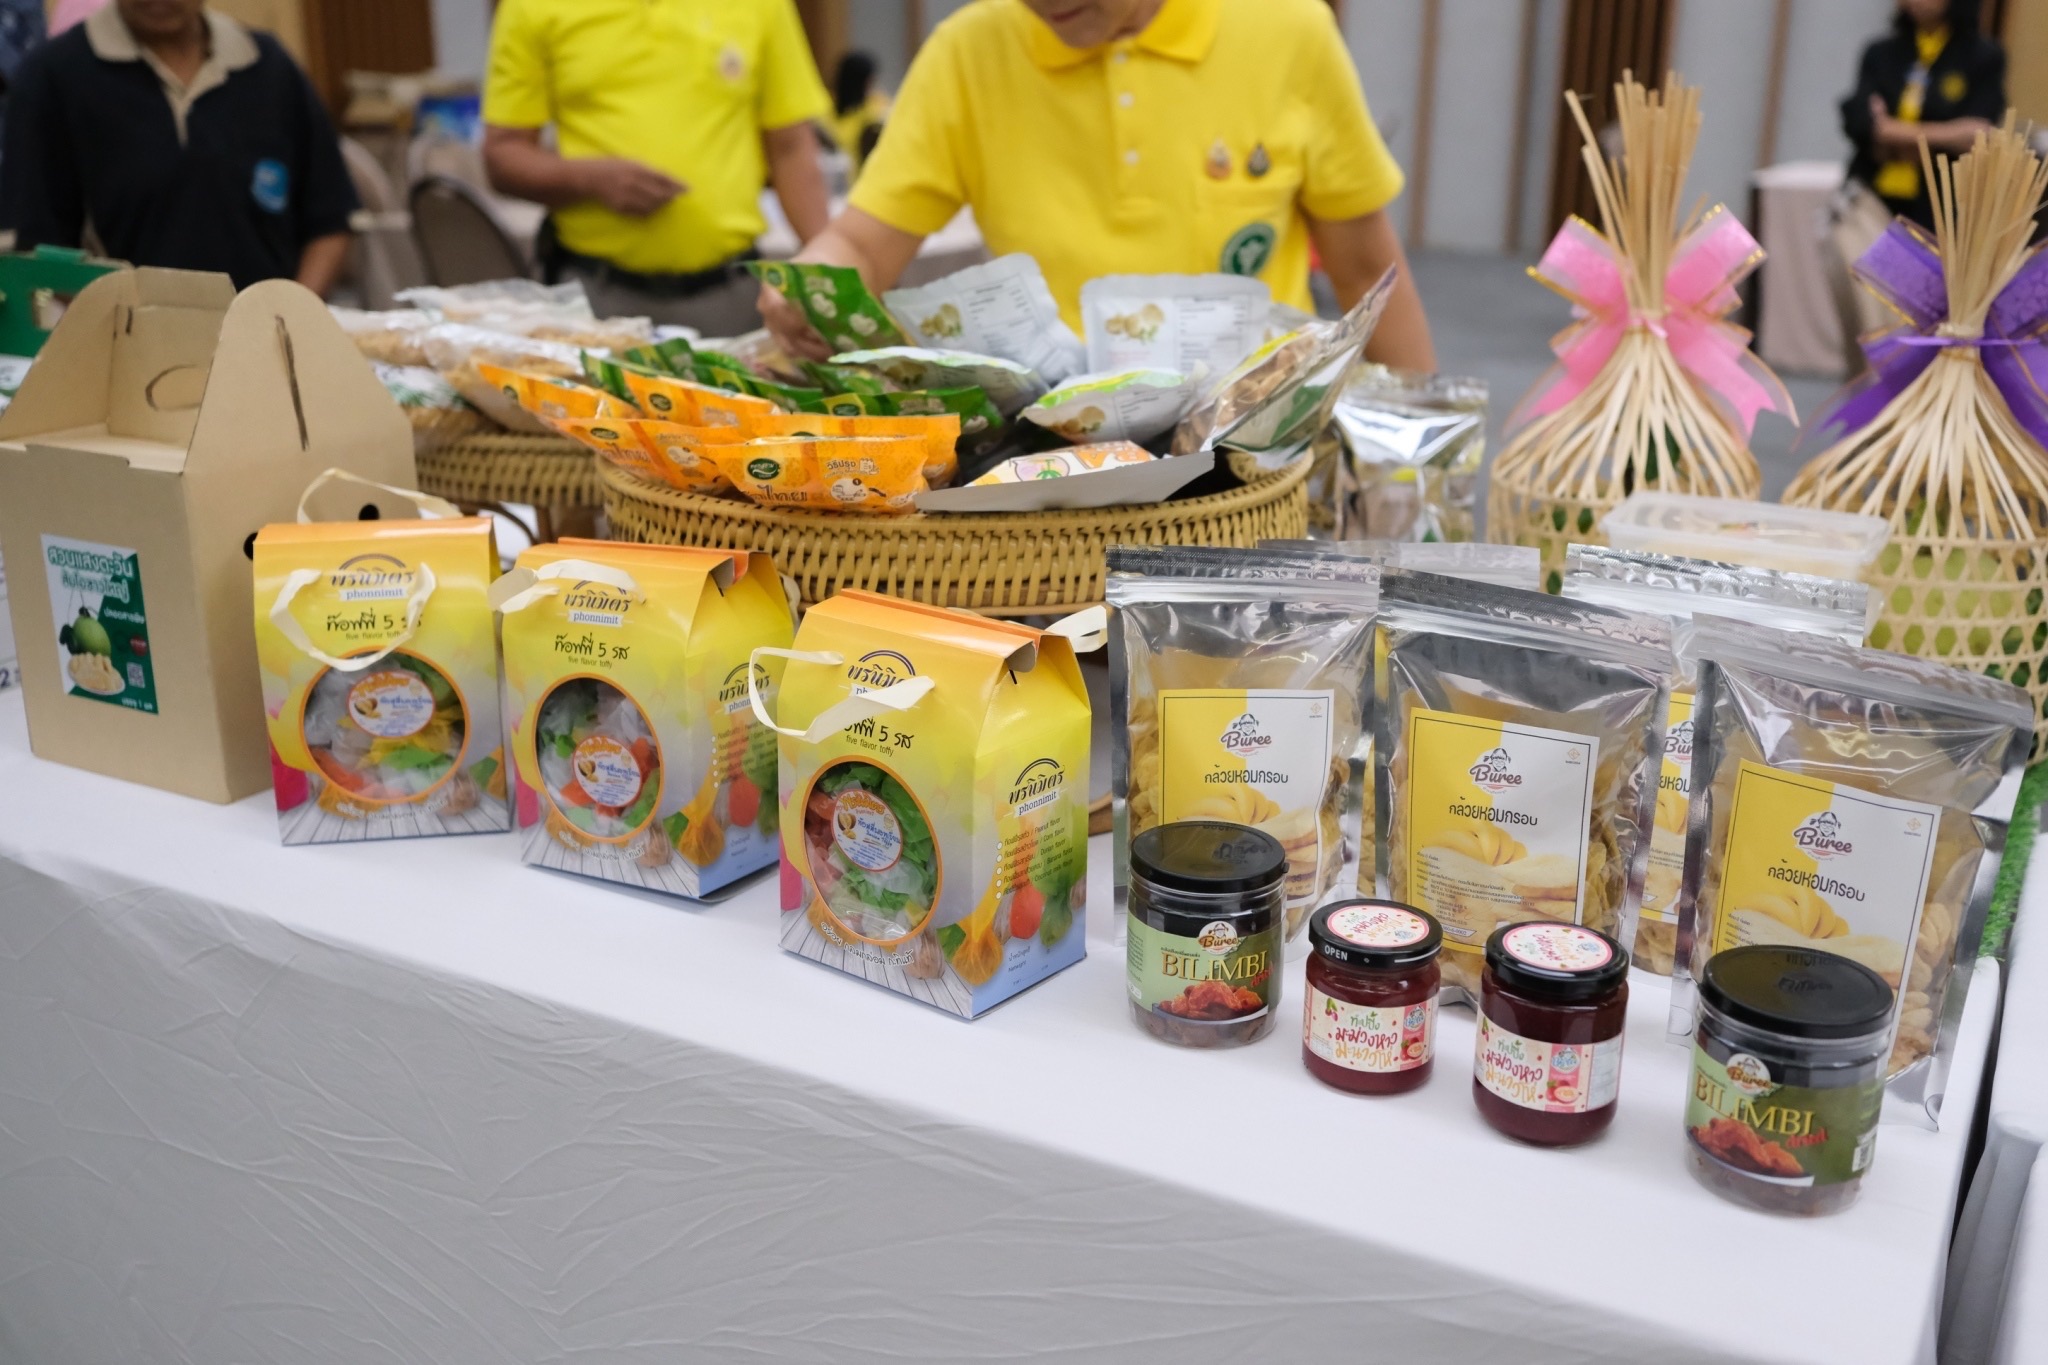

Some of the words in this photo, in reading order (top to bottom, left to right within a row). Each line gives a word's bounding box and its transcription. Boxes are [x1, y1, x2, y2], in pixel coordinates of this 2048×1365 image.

[346, 588, 404, 600] phonnimit
[383, 614, 394, 630] 5
[573, 611, 619, 625] phonnimit
[346, 632, 359, 640] five
[362, 632, 383, 640] flavor
[568, 656, 579, 665] five
[580, 657, 597, 667] flavor
[598, 642, 607, 658] 5
[612, 644, 630, 660] รส
[846, 735, 858, 745] five
[860, 738, 877, 751] flavor
[879, 744, 895, 757] toffy
[879, 725, 889, 742] 5
[894, 732, 914, 749] รส
[1221, 731, 1272, 750] Buree
[1009, 765, 1066, 805] พรนิมิตร
[1204, 764, 1289, 784] กล้วยหอมกรอบ
[1469, 763, 1522, 785] Buree
[1019, 791, 1057, 815] phonnimit
[1448, 796, 1538, 826] กล้วยหอมกรอบ
[1034, 822, 1050, 834] Peanut
[1050, 817, 1061, 827] flavor
[1055, 827, 1065, 837] flavor
[1793, 827, 1853, 854] Buree
[1767, 859, 1866, 902] กล้วยหอมกรอบ
[1199, 936, 1238, 948] Buree
[1324, 945, 1348, 961] OPEN
[1161, 950, 1267, 982] BILIMBI
[1335, 1026, 1398, 1050] มะม่วงหาว
[1486, 1048, 1543, 1083] มะม่วงหาว
[1727, 1066, 1773, 1088] Buree
[1696, 1070, 1814, 1135] BILIMBI
